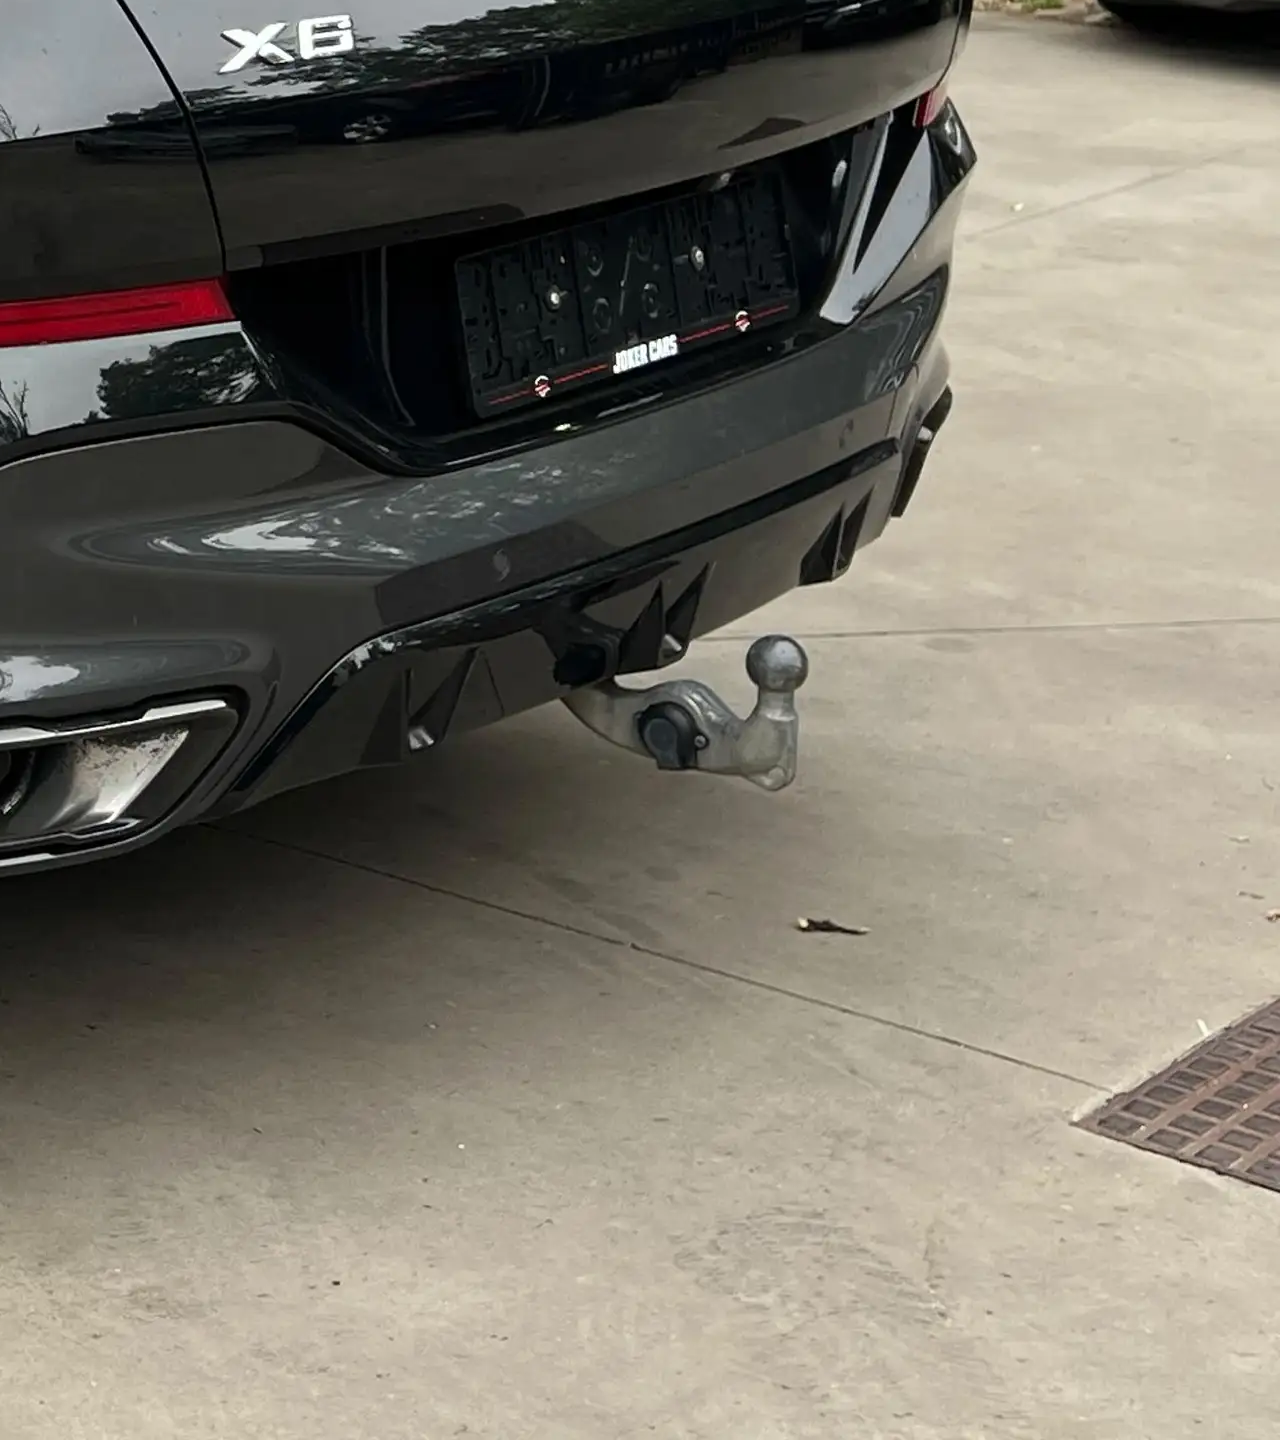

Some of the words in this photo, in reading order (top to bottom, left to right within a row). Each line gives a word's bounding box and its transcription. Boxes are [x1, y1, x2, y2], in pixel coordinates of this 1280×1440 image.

[217, 14, 354, 74] X6
[613, 344, 649, 374] JOKER
[649, 334, 679, 362] CARS
